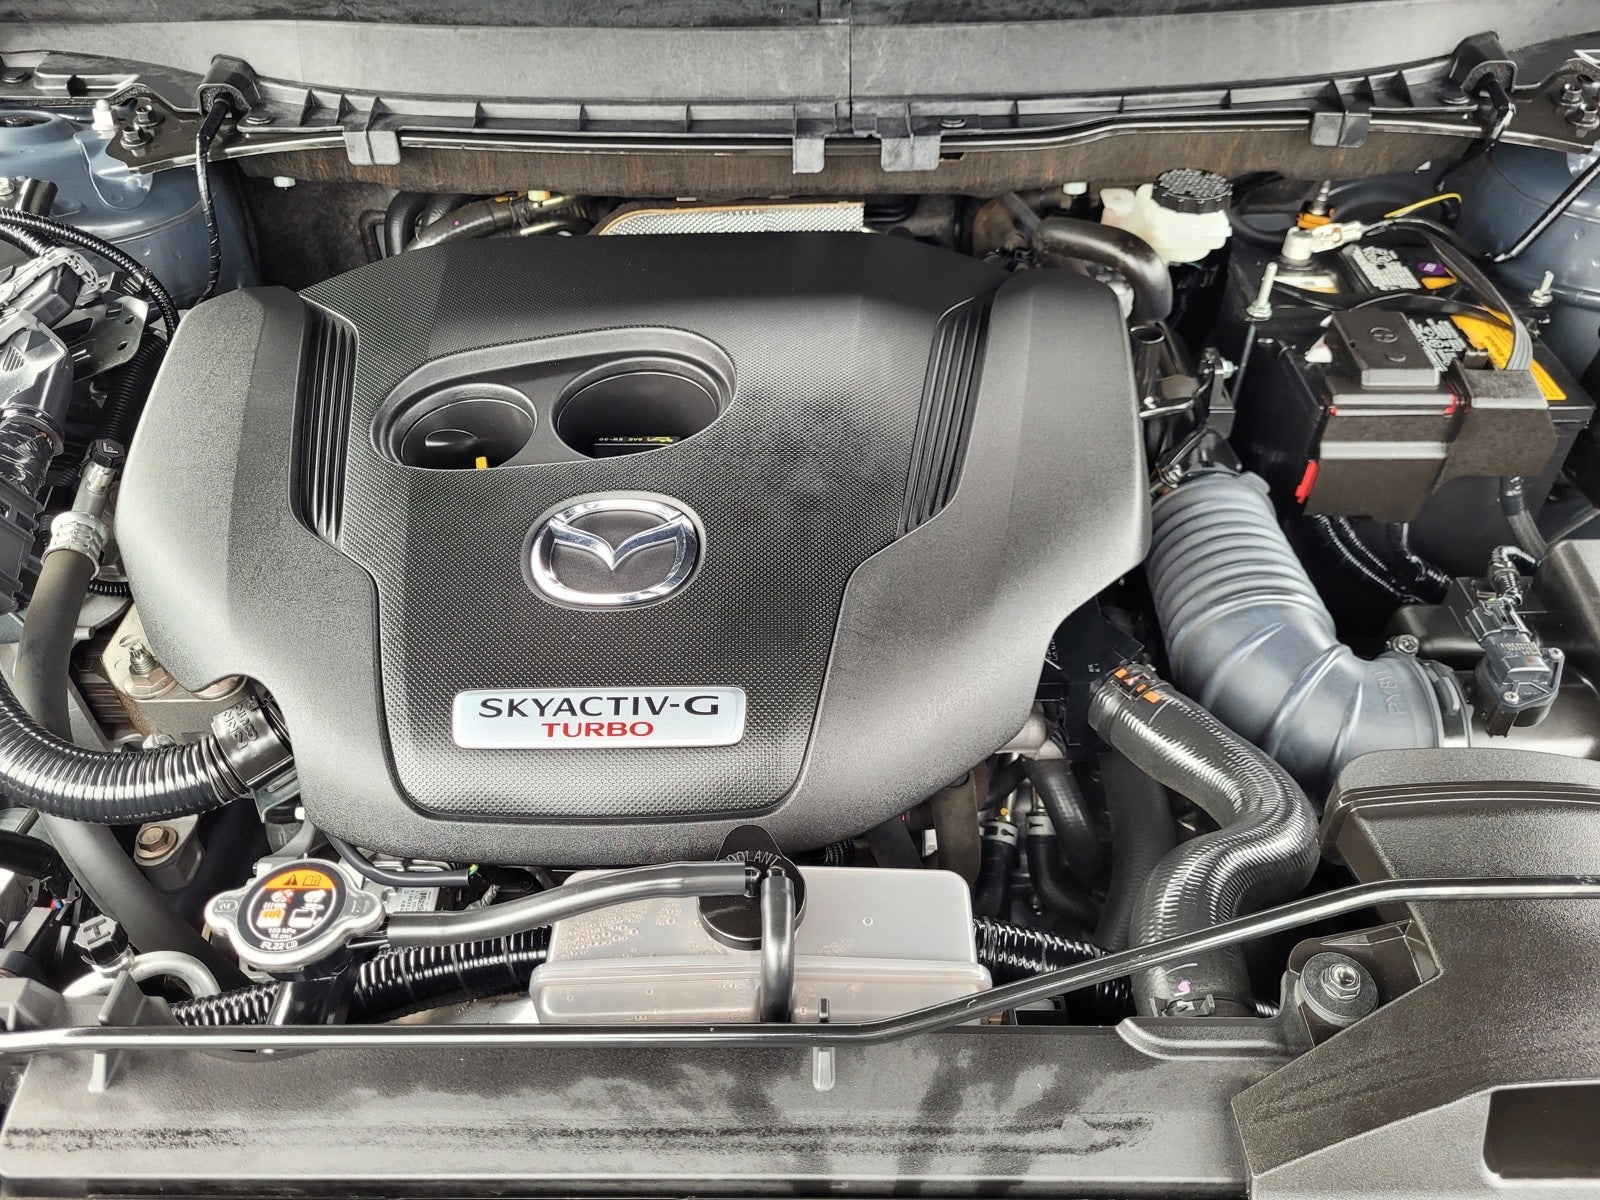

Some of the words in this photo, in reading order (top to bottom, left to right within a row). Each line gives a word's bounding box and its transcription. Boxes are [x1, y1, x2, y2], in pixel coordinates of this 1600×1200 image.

[479, 695, 719, 718] SKYACTIV-G
[541, 721, 654, 737] TURBO
[720, 850, 782, 867] OOLANT
[83, 919, 111, 946] H
